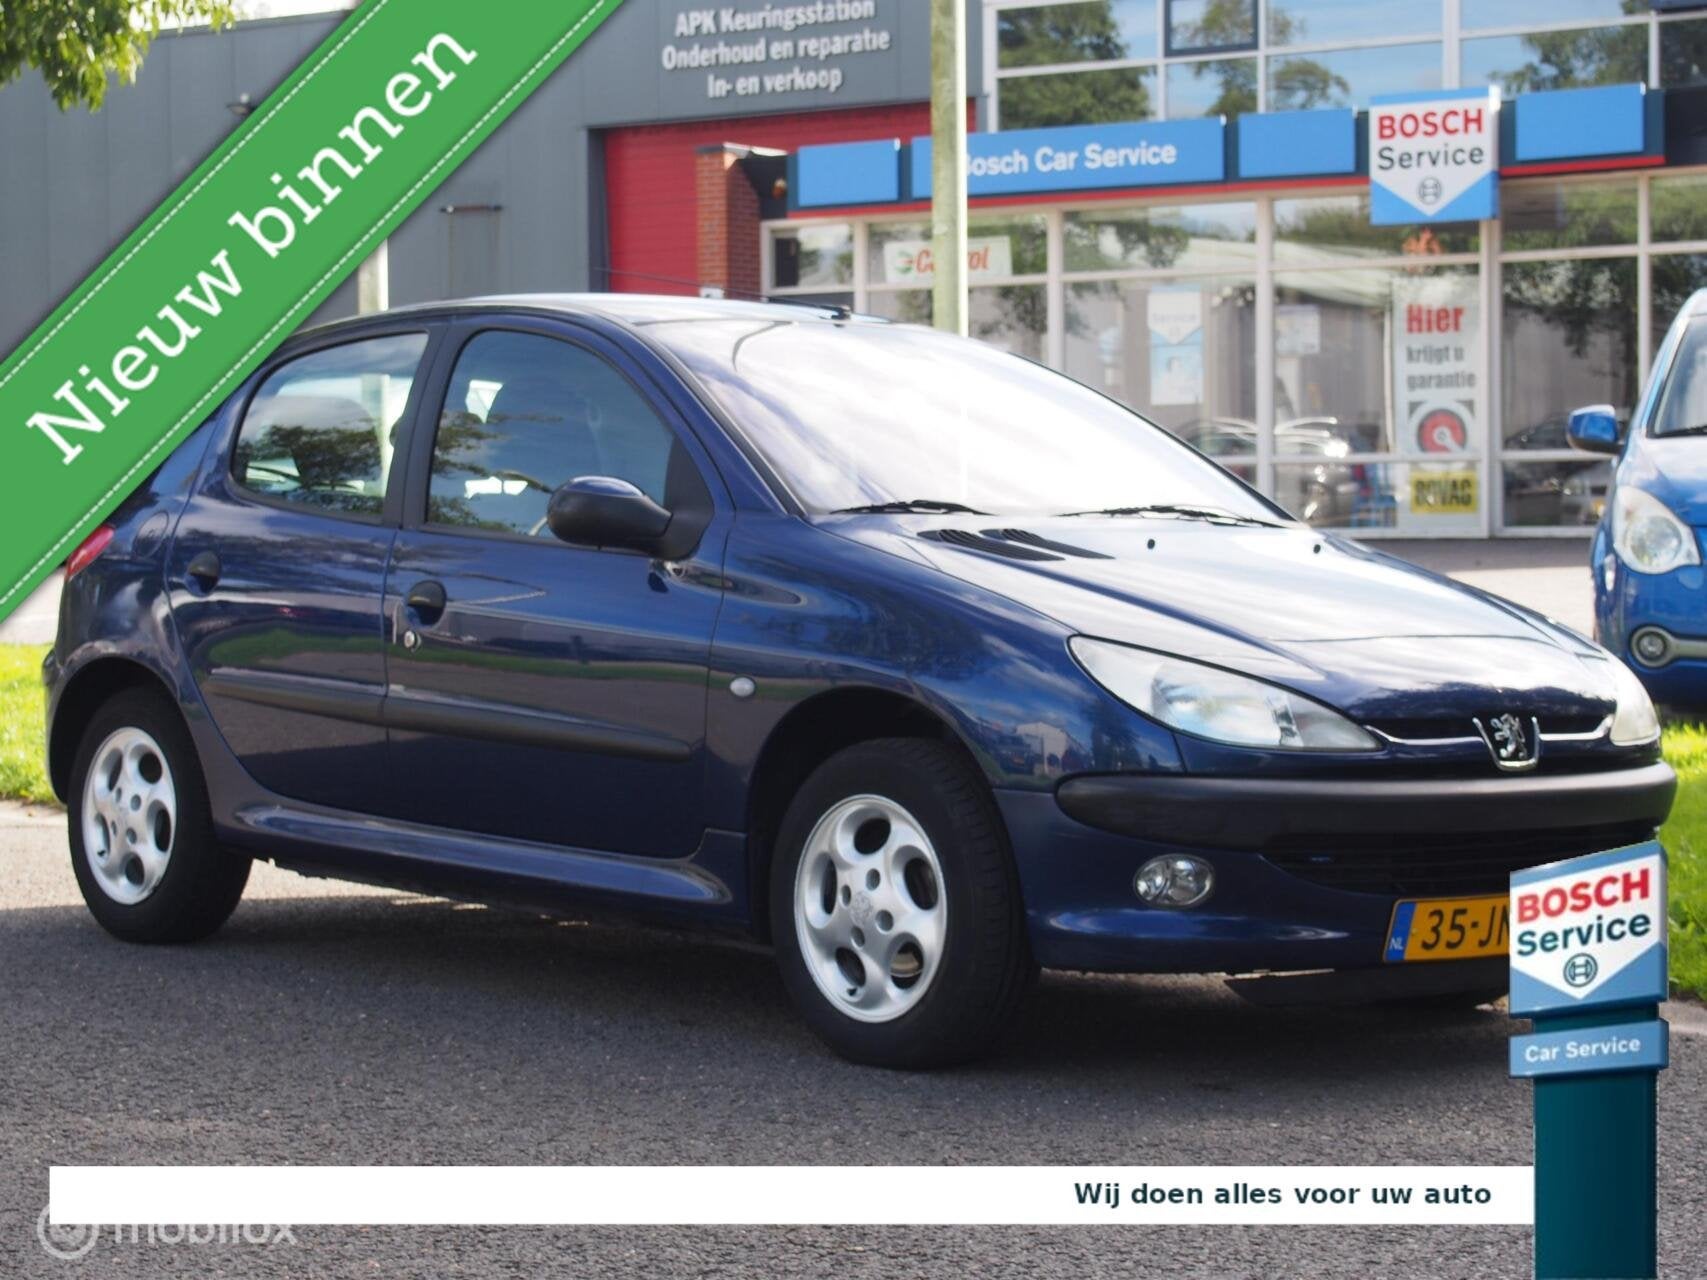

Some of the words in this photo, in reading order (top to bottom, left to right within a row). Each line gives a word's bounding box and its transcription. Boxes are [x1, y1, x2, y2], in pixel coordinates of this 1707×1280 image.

[675, 11, 717, 36] APK
[720, 0, 875, 32] Keuringsstation
[662, 38, 766, 70] Onderhoud
[769, 41, 794, 60] en
[798, 29, 890, 60] reparatie
[707, 75, 732, 98] In-
[735, 74, 761, 94] en
[764, 67, 842, 92] verkoop
[1378, 108, 1483, 139] BOSCH
[1034, 147, 1079, 172] Car
[1084, 141, 1177, 169] Service
[1377, 143, 1484, 170] Service
[1406, 304, 1464, 334] Hier
[1407, 370, 1476, 392] garantie
[1390, 937, 1404, 950] NL
